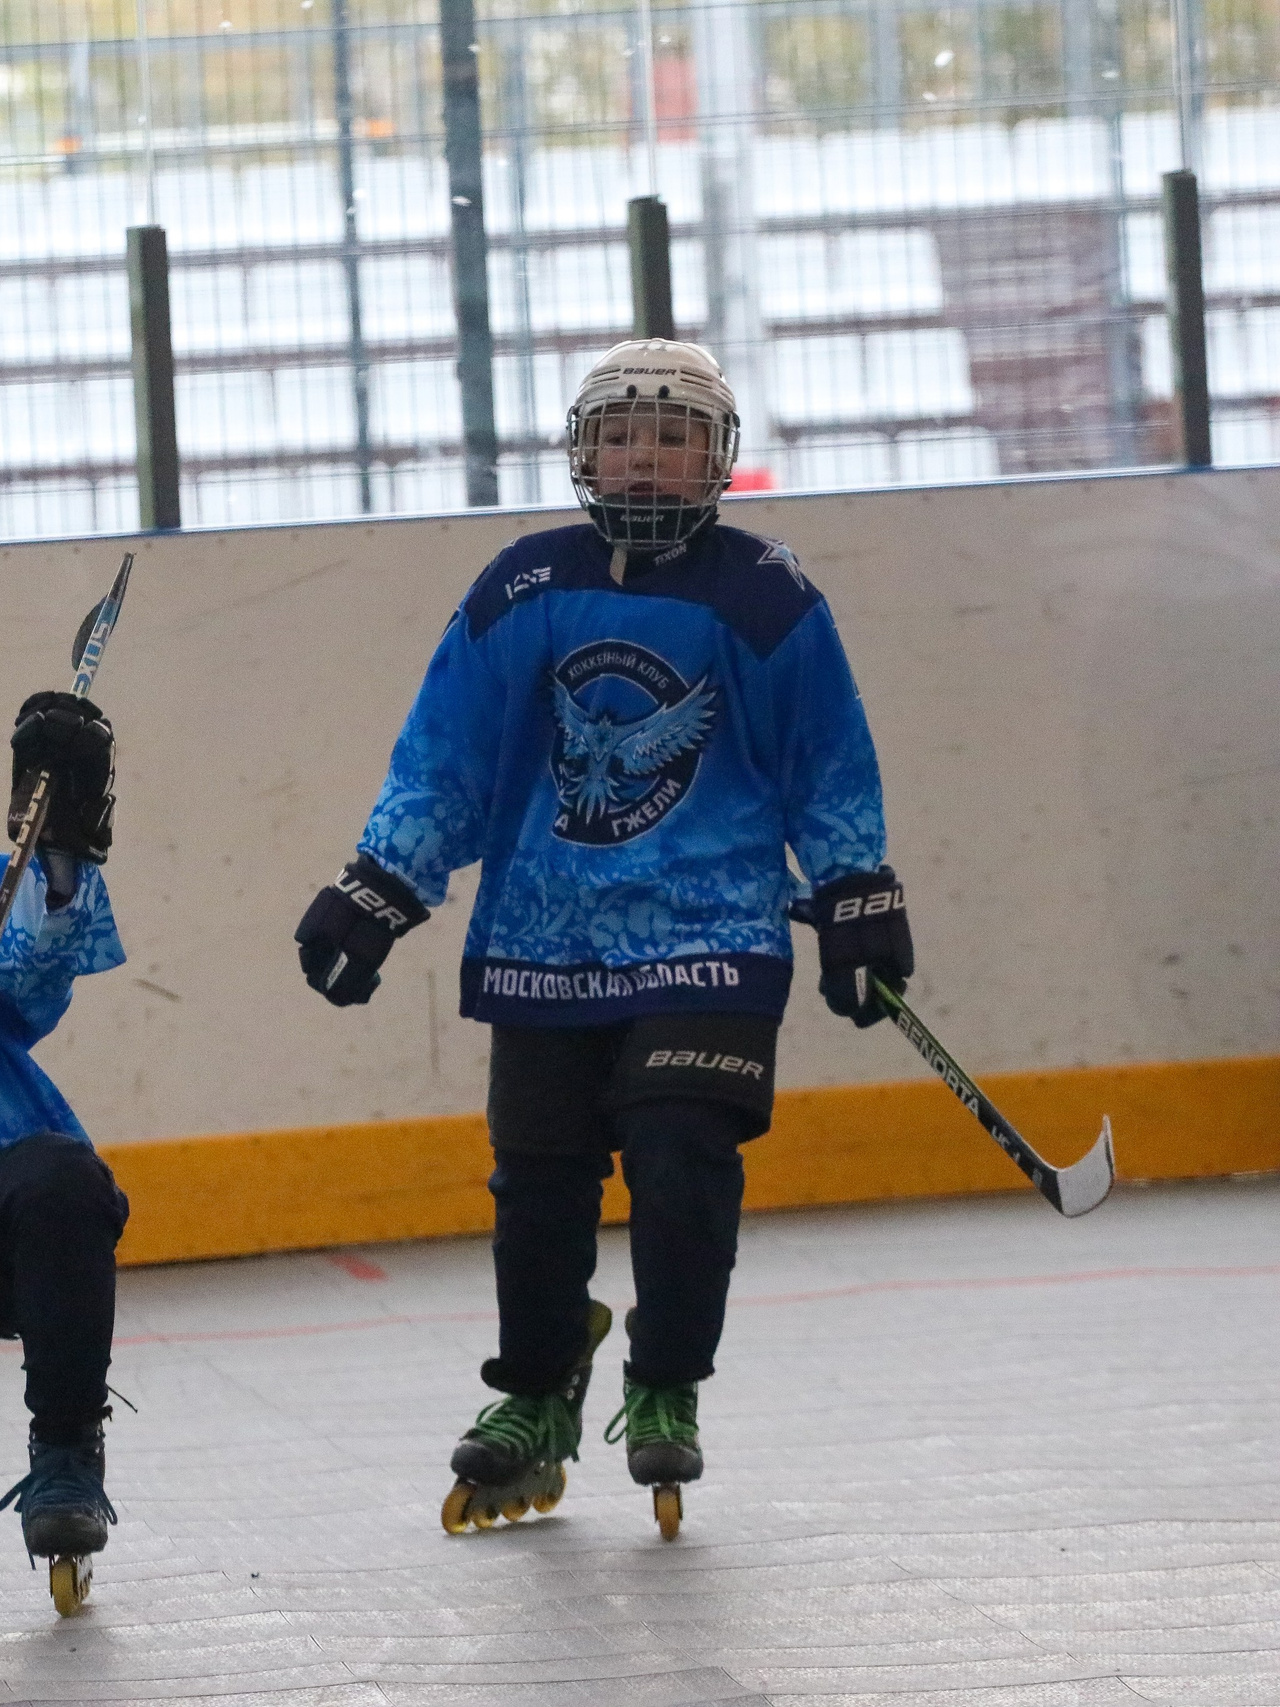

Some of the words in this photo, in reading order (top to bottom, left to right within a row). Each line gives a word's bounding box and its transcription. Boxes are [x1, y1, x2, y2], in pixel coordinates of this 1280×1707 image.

[622, 367, 678, 376] BAUER
[70, 622, 111, 698] EXUS
[637, 661, 670, 690] КЛУБ
[611, 778, 682, 837] ГЖЕЛИ
[334, 868, 408, 931] UER
[833, 888, 906, 923] BAU
[482, 965, 633, 1000] МОСКОВСКАЯ
[630, 960, 741, 992] ОБЛАСТЬ
[644, 1049, 765, 1081] BAUER
